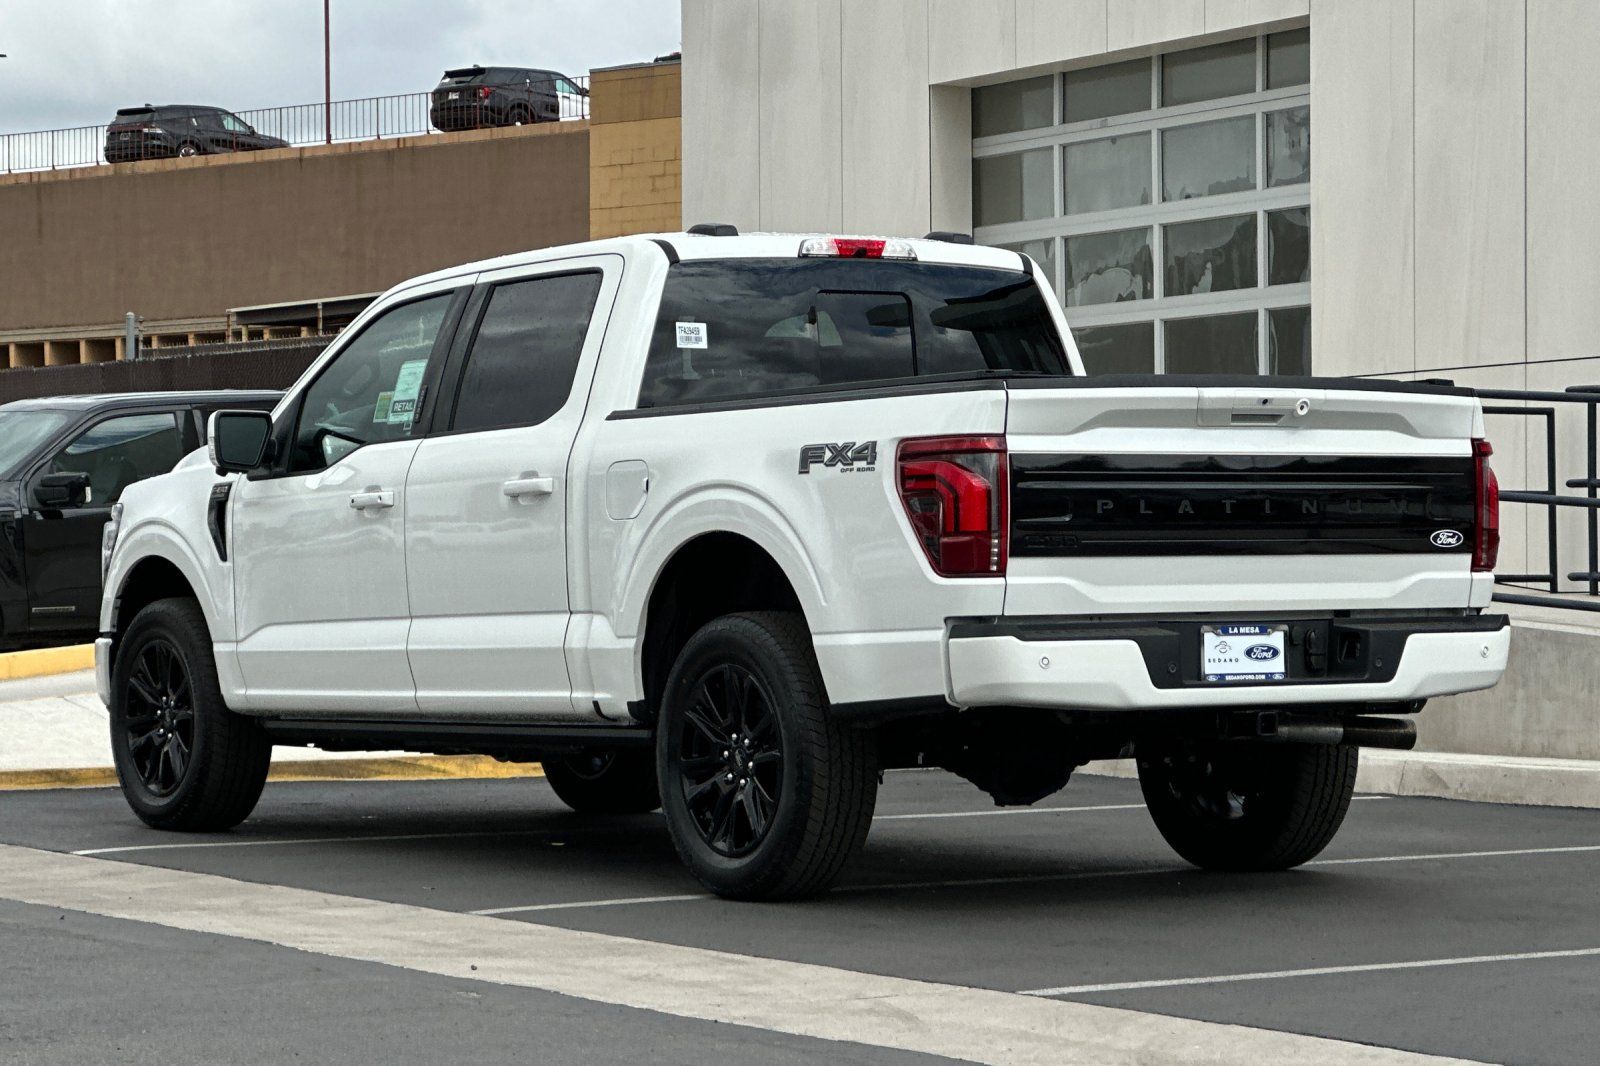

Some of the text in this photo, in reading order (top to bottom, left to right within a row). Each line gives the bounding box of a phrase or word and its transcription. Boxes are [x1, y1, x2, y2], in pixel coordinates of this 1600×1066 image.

[393, 400, 414, 412] RETAIL
[798, 440, 878, 475] FX4
[1228, 626, 1260, 634] LA MESA
